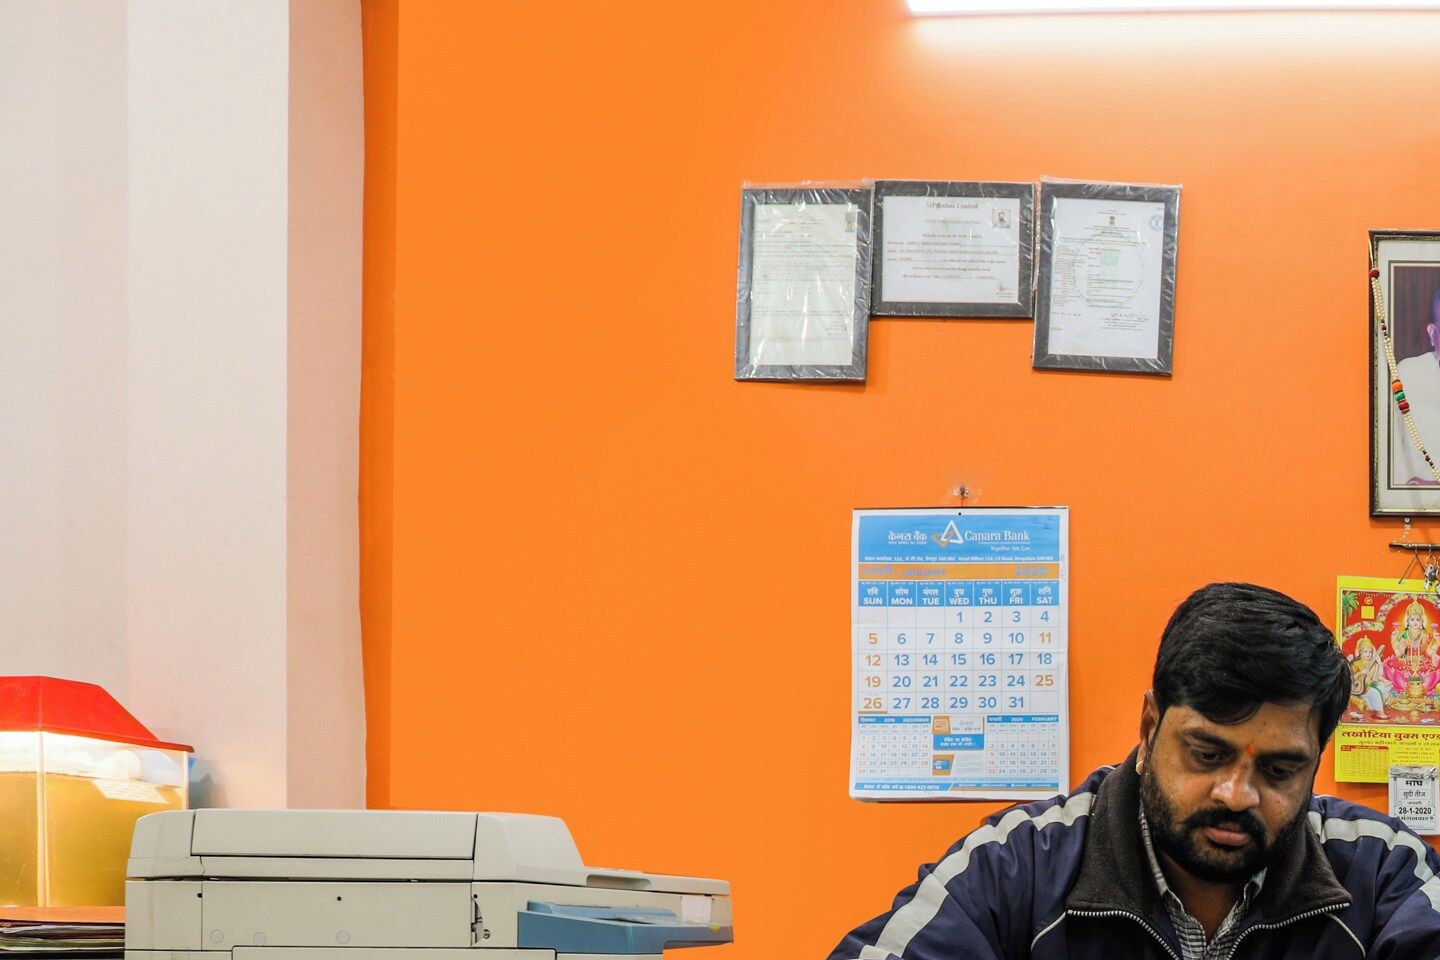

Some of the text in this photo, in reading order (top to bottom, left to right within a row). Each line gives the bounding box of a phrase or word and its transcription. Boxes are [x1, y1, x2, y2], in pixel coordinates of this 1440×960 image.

[964, 530, 1031, 541] Canara Bank
[864, 596, 1053, 605] SUN MON TUE WED THU FRI SAT
[957, 611, 1049, 622] 1 2 3 4
[869, 632, 1051, 644] 5 6 7 8 9 10 11
[866, 653, 1052, 666] 12 13 14 15 16 17 18
[865, 675, 1053, 687] 19 20 21 22 23 24 25
[863, 697, 1023, 709] 26 27 28 29 30 31
[1398, 807, 1432, 815] 28-1-2020
